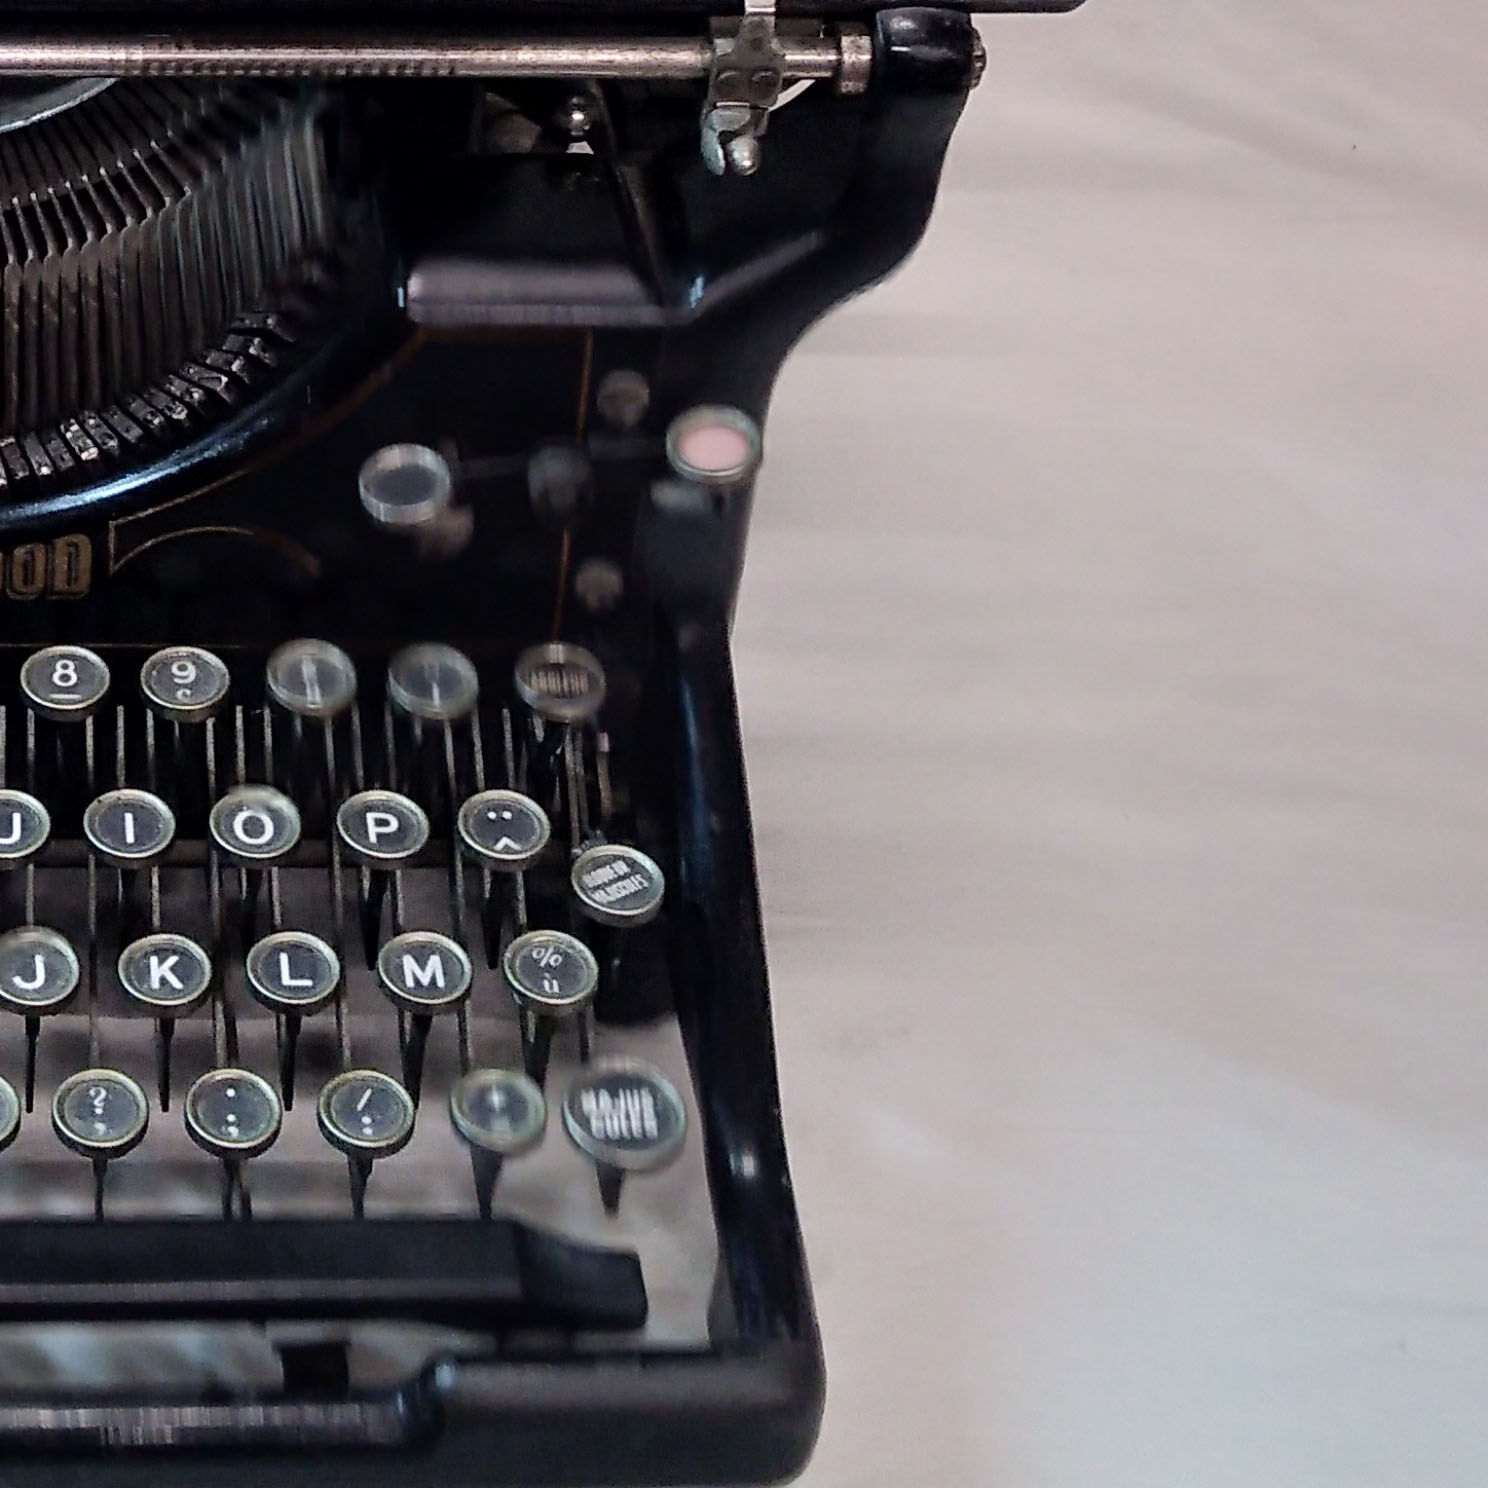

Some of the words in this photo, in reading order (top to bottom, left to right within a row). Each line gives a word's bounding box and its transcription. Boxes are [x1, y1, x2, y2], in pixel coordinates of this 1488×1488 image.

[52, 659, 79, 688] 8
[171, 660, 197, 684] 9
[124, 812, 135, 844] I
[233, 811, 275, 846] O
[366, 811, 400, 845] P
[12, 954, 46, 991] J
[149, 955, 184, 990] K
[279, 952, 314, 987] L
[402, 954, 446, 988] M
